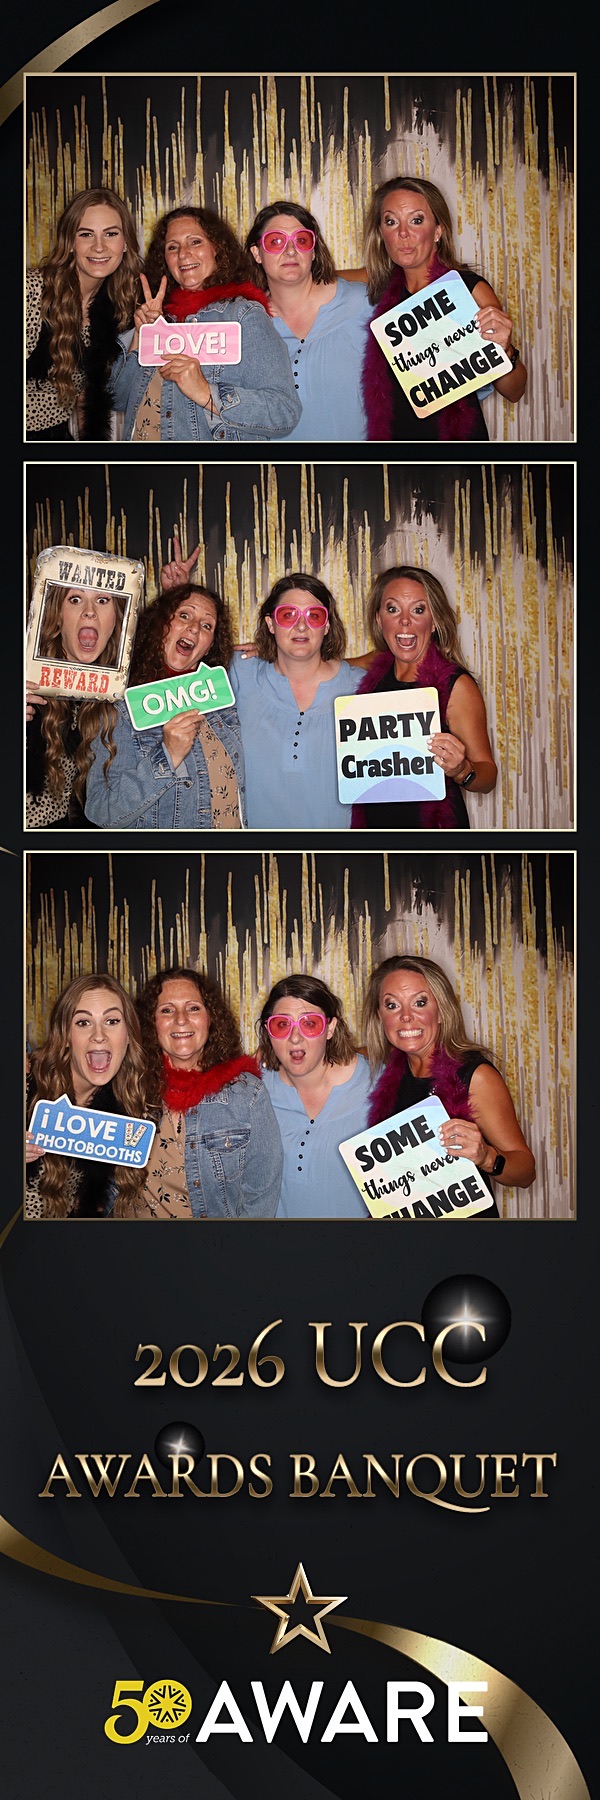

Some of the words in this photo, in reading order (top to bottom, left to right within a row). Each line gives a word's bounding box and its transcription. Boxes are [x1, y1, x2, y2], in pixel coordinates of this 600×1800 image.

[385, 289, 456, 347] SOME
[153, 332, 227, 355] LOVE!
[392, 342, 440, 373] things
[409, 343, 504, 407] CHANGE
[58, 560, 126, 591] WANTED
[39, 666, 109, 694] REWARD
[142, 679, 218, 715] OMG!
[339, 710, 436, 742] PARTY
[341, 751, 435, 779] Crasher
[54, 1111, 118, 1141] LOVE
[35, 1132, 143, 1163] PHOTOBOOTHS
[354, 1114, 435, 1172] SOME
[362, 1170, 415, 1200] things
[382, 1175, 485, 1218] HANGE
